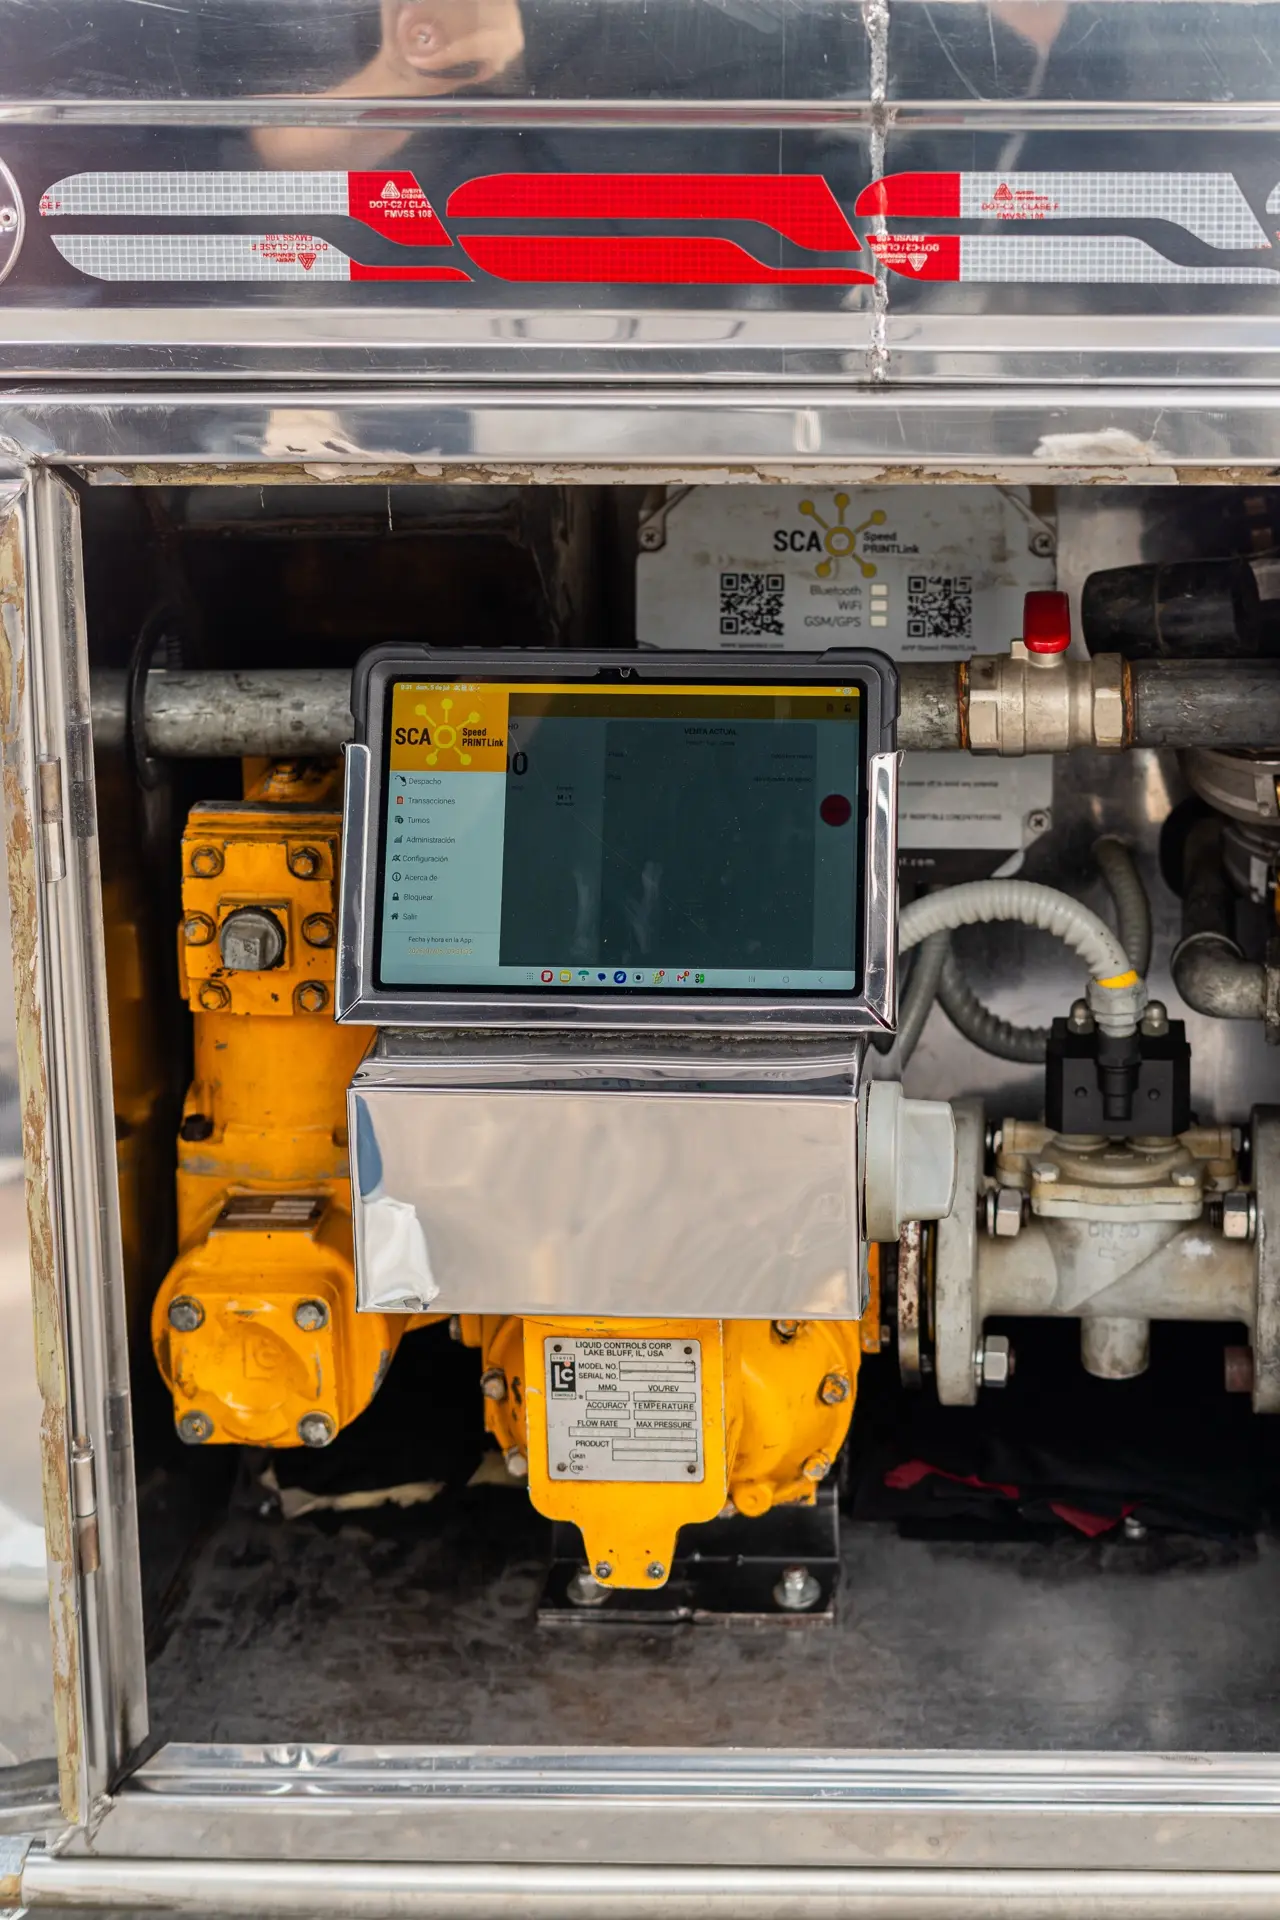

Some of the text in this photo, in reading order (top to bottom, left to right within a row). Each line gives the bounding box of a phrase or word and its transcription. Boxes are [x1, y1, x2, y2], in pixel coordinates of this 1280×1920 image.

[369, 200, 402, 209] DOT-C2
[384, 209, 432, 218] FMVSS 108
[251, 243, 257, 251] F
[260, 243, 289, 251] CLASE
[296, 243, 328, 251] DOT-C2
[906, 243, 940, 252] DOT-C2
[863, 532, 897, 542] Speed
[773, 530, 822, 553] SCA
[809, 585, 863, 596] Bluetooth
[838, 601, 863, 611] WiFi
[804, 616, 862, 627] GSM/GPS
[395, 727, 432, 745] SCA
[462, 728, 487, 737] Speed
[408, 778, 442, 786] Despacho
[408, 797, 456, 805] Transacciones
[406, 836, 456, 844] Administración
[402, 855, 449, 863] Configuración
[403, 894, 433, 902] Bloquear
[575, 1341, 602, 1349] LIQUID
[602, 1342, 647, 1350] CONTROLS
[583, 1349, 604, 1357] LAKE
[606, 1350, 634, 1358] BLUFF,
[647, 1350, 664, 1358] USA
[578, 1362, 604, 1370] MODEL
[578, 1372, 604, 1380] SERIAL
[598, 1384, 617, 1392] MMQ
[648, 1385, 679, 1393] VOL/REV
[633, 1402, 694, 1410] TEMPERATURE
[654, 1421, 692, 1429] PRESSURE
[575, 1440, 610, 1448] PRODUCT
